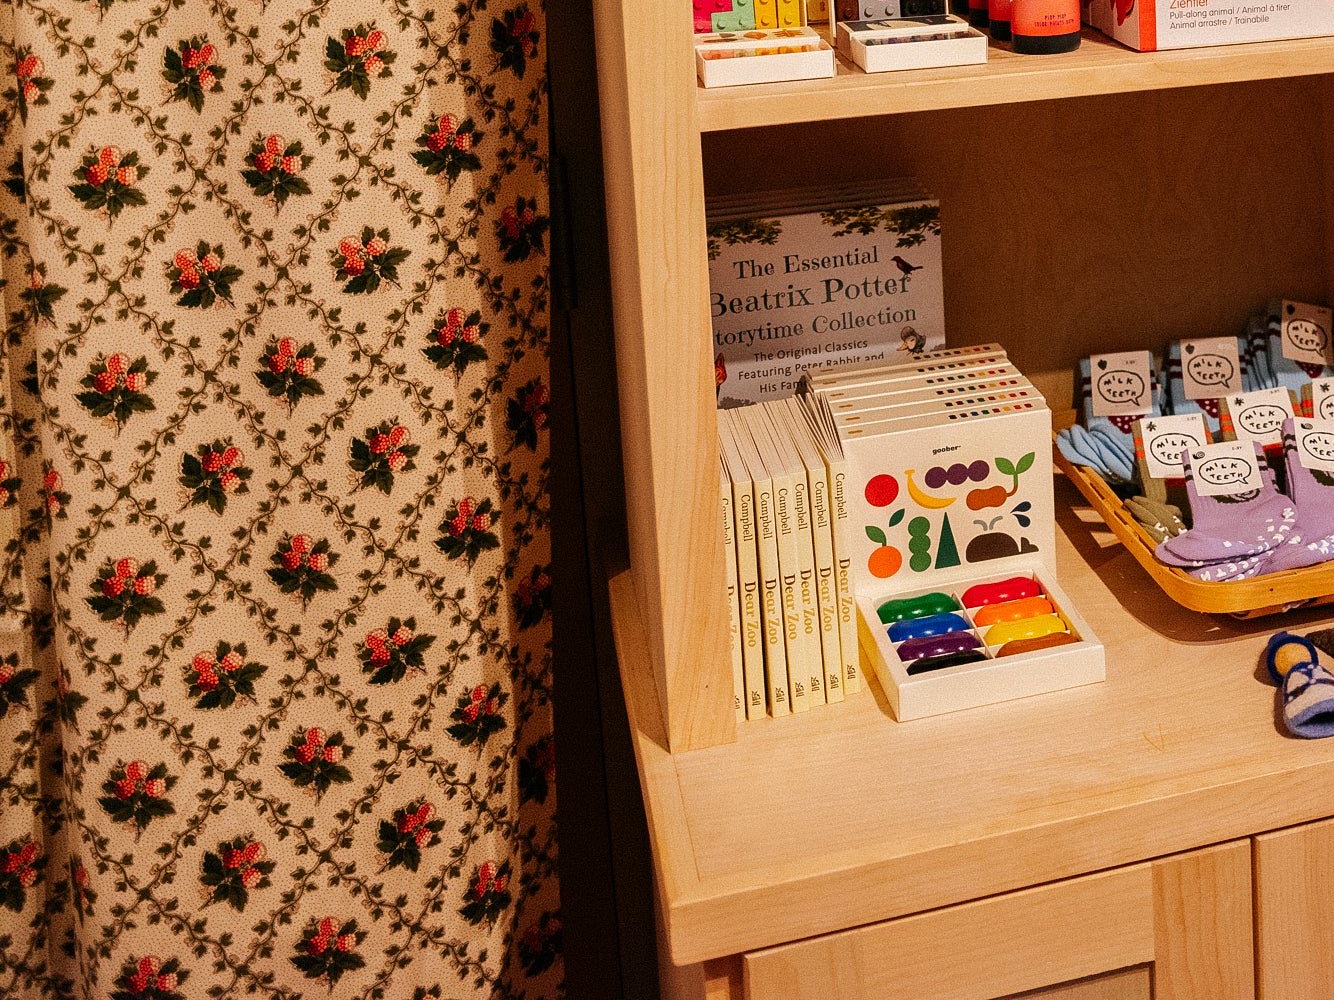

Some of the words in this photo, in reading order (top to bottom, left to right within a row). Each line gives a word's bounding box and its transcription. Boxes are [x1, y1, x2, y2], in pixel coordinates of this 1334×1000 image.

[1170, 10, 1207, 19] Pull-along
[1209, 7, 1235, 16] animal
[1242, 4, 1267, 14] Animal
[1276, 3, 1291, 11] tirer
[1170, 20, 1197, 29] Animal
[1198, 18, 1227, 27] arrastre
[1234, 15, 1270, 24] Trainabile
[733, 259, 775, 280] The
[783, 245, 879, 275] Essential
[710, 285, 814, 318] Beatrix
[820, 274, 911, 305] Potter
[715, 320, 804, 348] torytime
[812, 306, 917, 335] Collection
[1292, 323, 1319, 336] MILK
[753, 351, 774, 362] The
[776, 344, 821, 360] Original
[825, 340, 868, 353] Classics
[1294, 334, 1320, 348] TEETH
[738, 366, 791, 381] Featuring
[1194, 358, 1222, 368] MILK
[1196, 371, 1226, 380] TEETH
[760, 381, 777, 393] His
[1104, 375, 1133, 386] MILK
[1106, 389, 1136, 397] TEETH
[1245, 410, 1275, 420] MILK
[1250, 420, 1281, 429] TEETH
[932, 445, 959, 455] goober
[1157, 438, 1188, 448] MILK
[1160, 451, 1183, 460] TEE
[1205, 462, 1238, 472] MILK
[1210, 472, 1243, 480] TEETH
[795, 483, 808, 530] Campbell
[815, 481, 827, 528] Campbell
[835, 473, 847, 519] Campbell
[740, 494, 753, 541] Campbell
[760, 492, 773, 540] Campbell
[778, 488, 791, 535] Campbell
[800, 569, 812, 604] Dear
[820, 567, 832, 602] Dear
[839, 557, 851, 593] Dear
[744, 581, 756, 617] Dear
[765, 578, 777, 615] Dear
[784, 574, 796, 610] Dear
[803, 608, 815, 635] Zoo
[822, 605, 835, 632] Zoo
[840, 596, 853, 623] Zoo
[746, 621, 759, 648] Zoo
[767, 618, 780, 644] Zoo
[786, 614, 799, 640] Zoo
